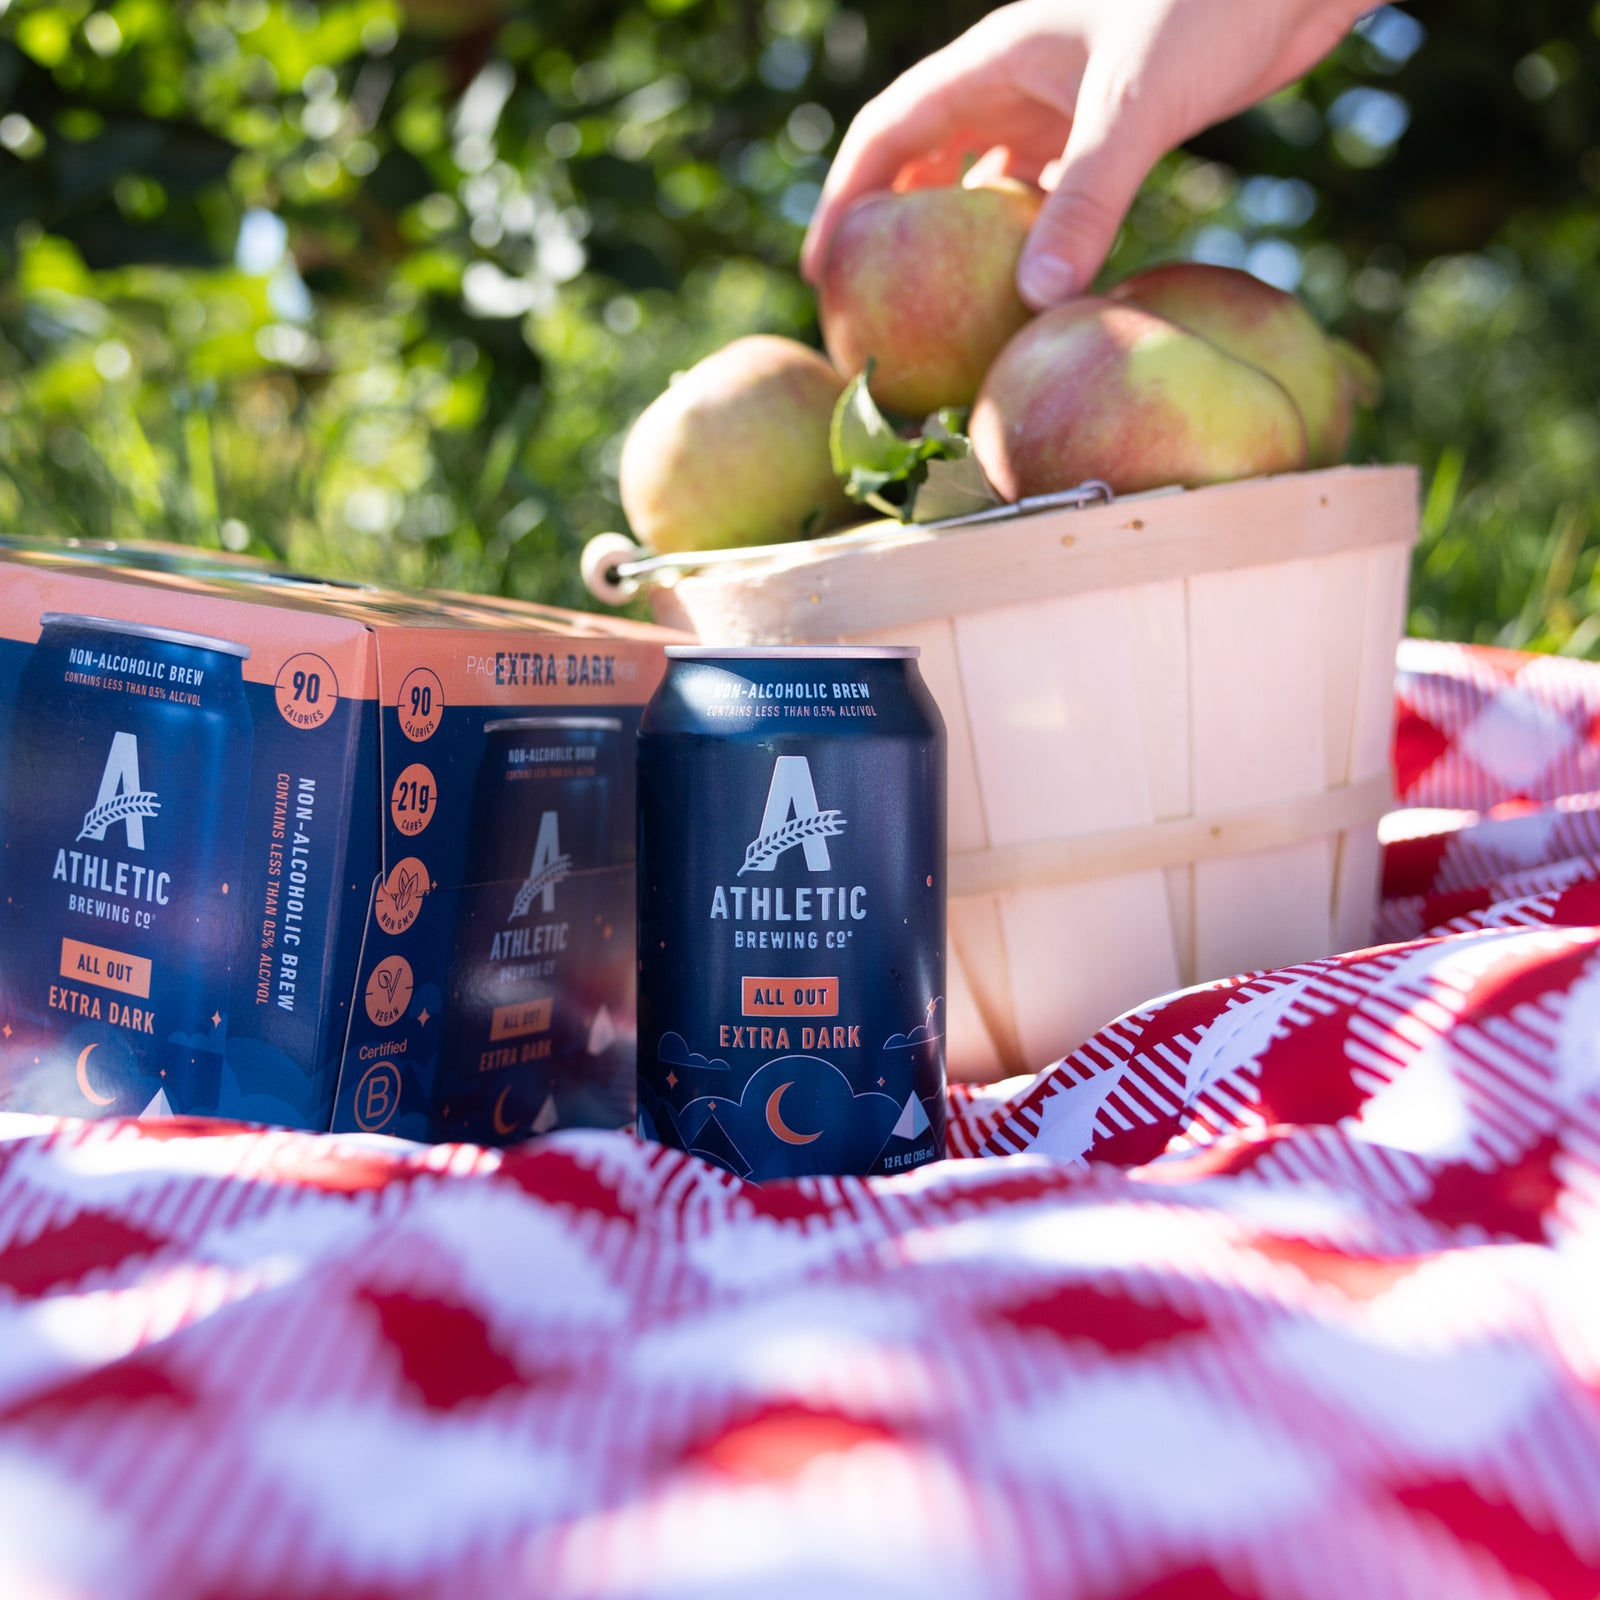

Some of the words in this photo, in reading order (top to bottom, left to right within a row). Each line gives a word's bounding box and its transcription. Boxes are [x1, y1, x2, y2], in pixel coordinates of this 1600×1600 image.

[69, 648, 165, 679] NON-ALCOHOLIC
[169, 665, 204, 686] BREW
[496, 652, 557, 685] EXTRA
[567, 654, 615, 686] DARK
[64, 671, 101, 687] CONTAINS
[103, 678, 123, 691] LESS
[126, 681, 147, 696] THAN
[169, 690, 202, 707] ALC/VOL
[293, 671, 320, 704] 90
[411, 686, 431, 717] 90
[713, 683, 828, 699] NON-ALCOHOLIC
[832, 683, 870, 699] BREW
[283, 704, 324, 725] CALORIES
[706, 705, 752, 717] CONTAINS
[755, 705, 780, 717] LESS
[783, 705, 811, 717] THAN
[813, 705, 836, 717] 0.5%
[839, 705, 878, 717] ALC/VOL
[404, 720, 435, 738] CALORIES
[272, 773, 290, 839] CONTAINS
[398, 781, 430, 814] 21g
[401, 818, 423, 832] CARBS
[268, 843, 284, 876] LESS
[283, 778, 316, 946] NON-ALCOHOLIC
[53, 848, 171, 906] ATHLETIC
[69, 894, 130, 924] BREWING
[265, 881, 280, 916] THAN
[710, 886, 867, 921] ATHLETIC
[381, 912, 396, 930] NON
[397, 910, 414, 930] GMO
[490, 922, 570, 961] ATHLETIC
[734, 930, 818, 949] BREWING
[77, 954, 100, 975] ALL
[106, 961, 133, 983] OUT
[256, 953, 272, 1005] ALC/VOL
[277, 953, 298, 1012] BREW
[49, 985, 101, 1020] EXTRA
[109, 1002, 155, 1035] DARK
[754, 988, 785, 1005] ALL
[794, 988, 828, 1005] OUT
[375, 1006, 399, 1022] VEGAN
[359, 1038, 408, 1061] Certified
[719, 1025, 790, 1049] EXTRA
[802, 1025, 862, 1049] DARK
[479, 1048, 518, 1072] EXTRA
[365, 1075, 390, 1119] B
[884, 1157, 893, 1168] 12
[894, 1155, 903, 1167] FL
[903, 1152, 912, 1165] OZ
